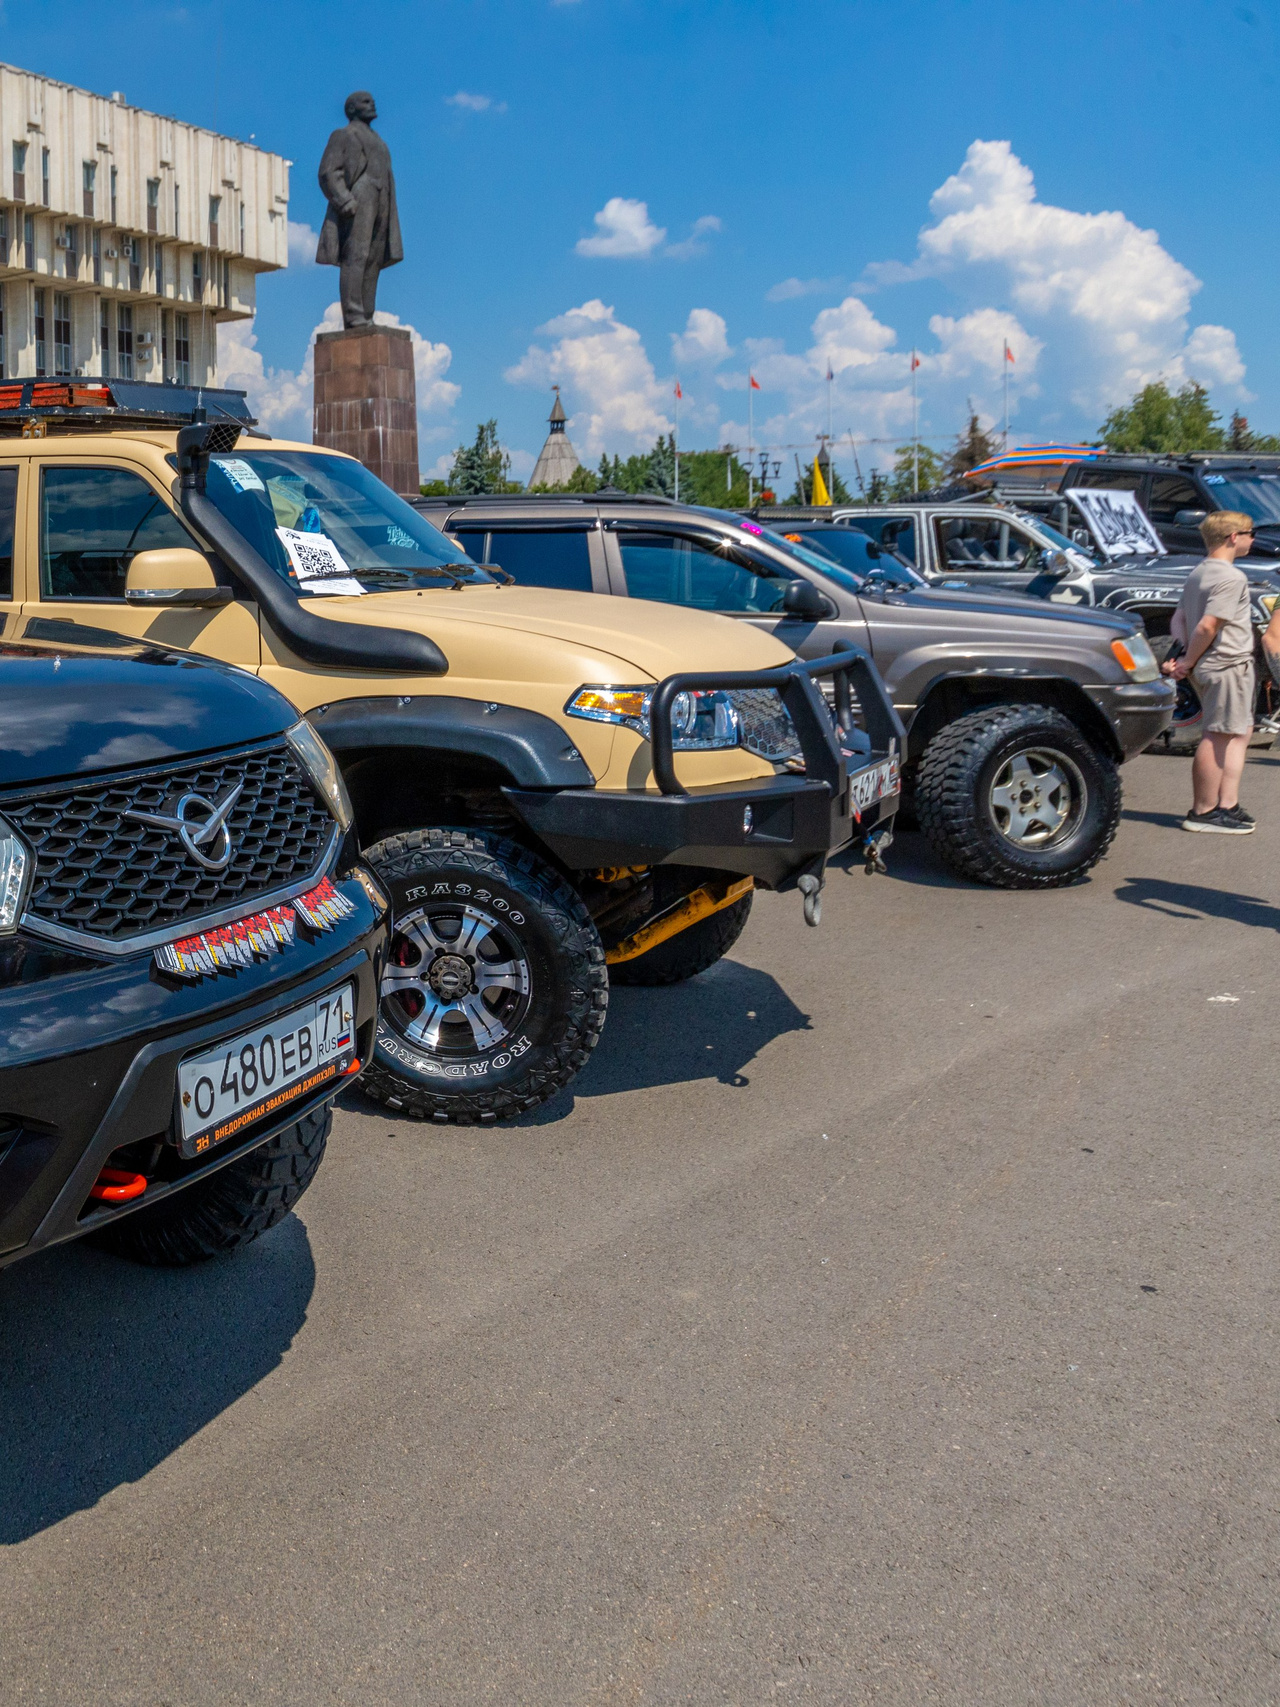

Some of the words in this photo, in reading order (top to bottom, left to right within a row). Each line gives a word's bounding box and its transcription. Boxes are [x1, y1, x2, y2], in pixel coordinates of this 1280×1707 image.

[406, 882, 525, 925] RA3200
[319, 995, 344, 1042] 71
[318, 1036, 337, 1057] RUS
[214, 1106, 265, 1141] ВНЕДОРОЖНАЯ
[265, 1083, 302, 1111] ЭВАКУАЦИЯ
[302, 1064, 336, 1092] ДЖИПХЭЛП
